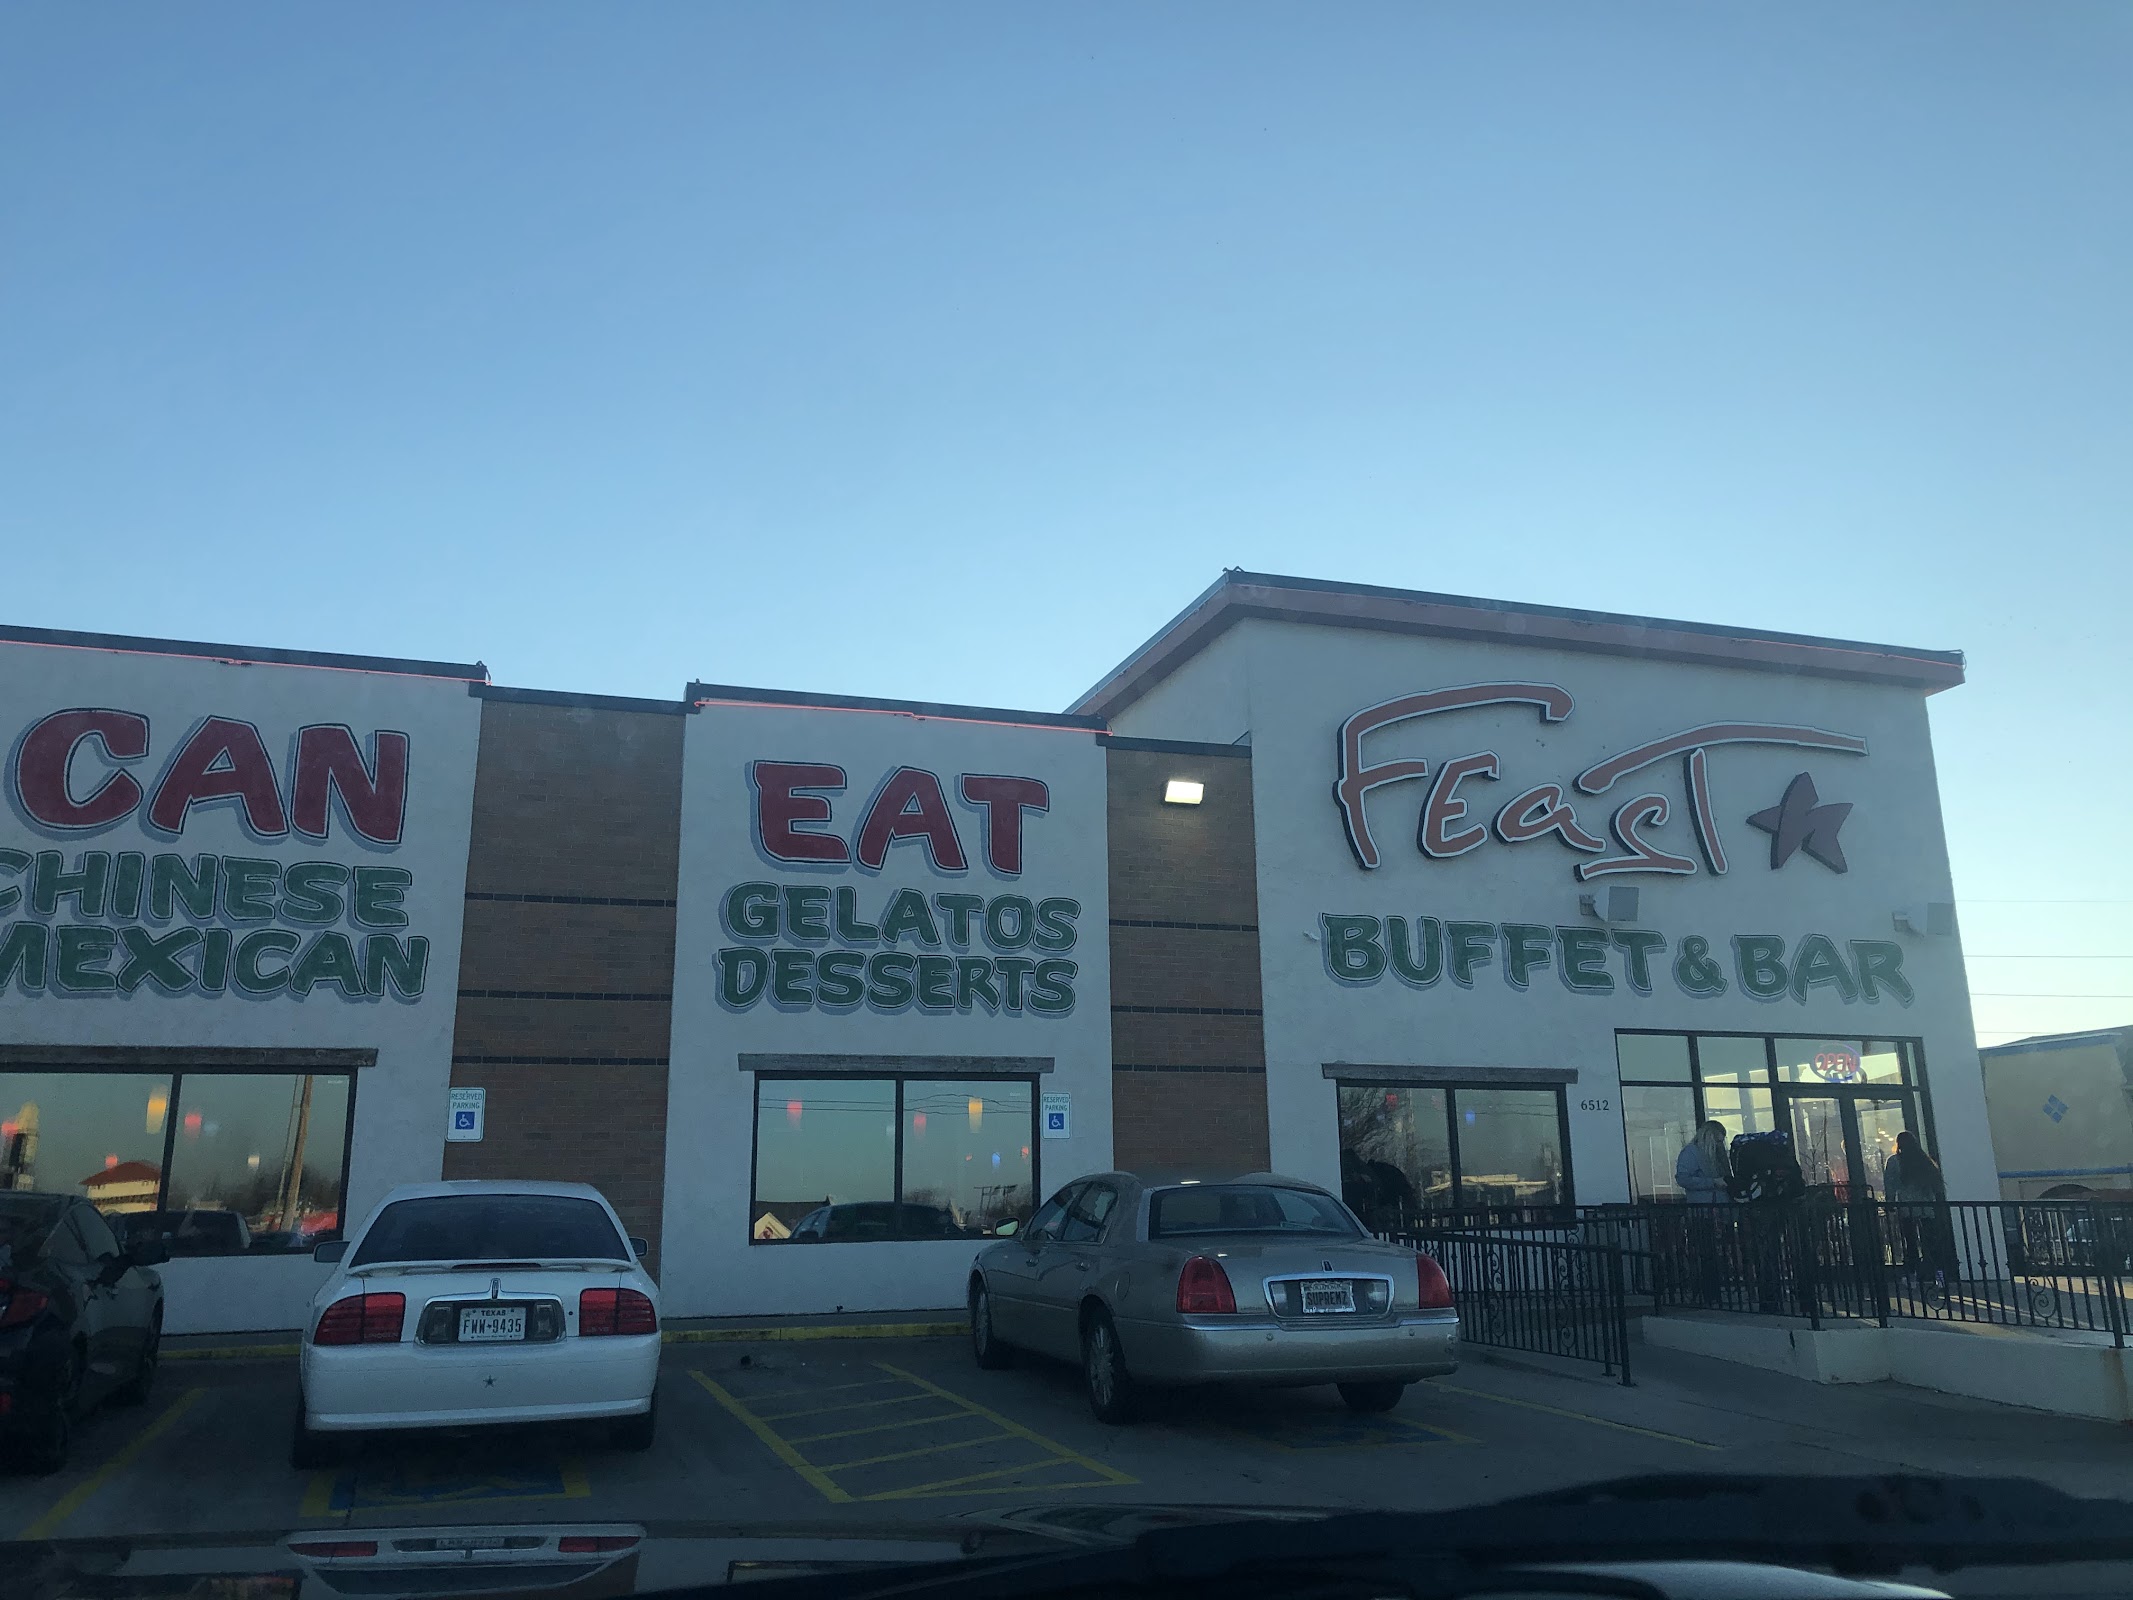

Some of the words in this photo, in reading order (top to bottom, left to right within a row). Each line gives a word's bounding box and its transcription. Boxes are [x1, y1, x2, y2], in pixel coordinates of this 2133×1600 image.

[11, 707, 411, 848] CAN
[748, 760, 1050, 877] EAT
[720, 881, 1082, 951] GELATOS
[1320, 911, 1667, 994] BUFFET
[1674, 935, 1728, 997] &
[1732, 932, 1915, 1006] BAR
[713, 947, 1079, 1015] DESSERTS
[1814, 1053, 1857, 1072] OPEN
[451, 1093, 482, 1101] RESERVED
[1043, 1096, 1069, 1104] RESERVED
[1580, 1099, 1610, 1111] 6512
[480, 1309, 507, 1317] TEXAS
